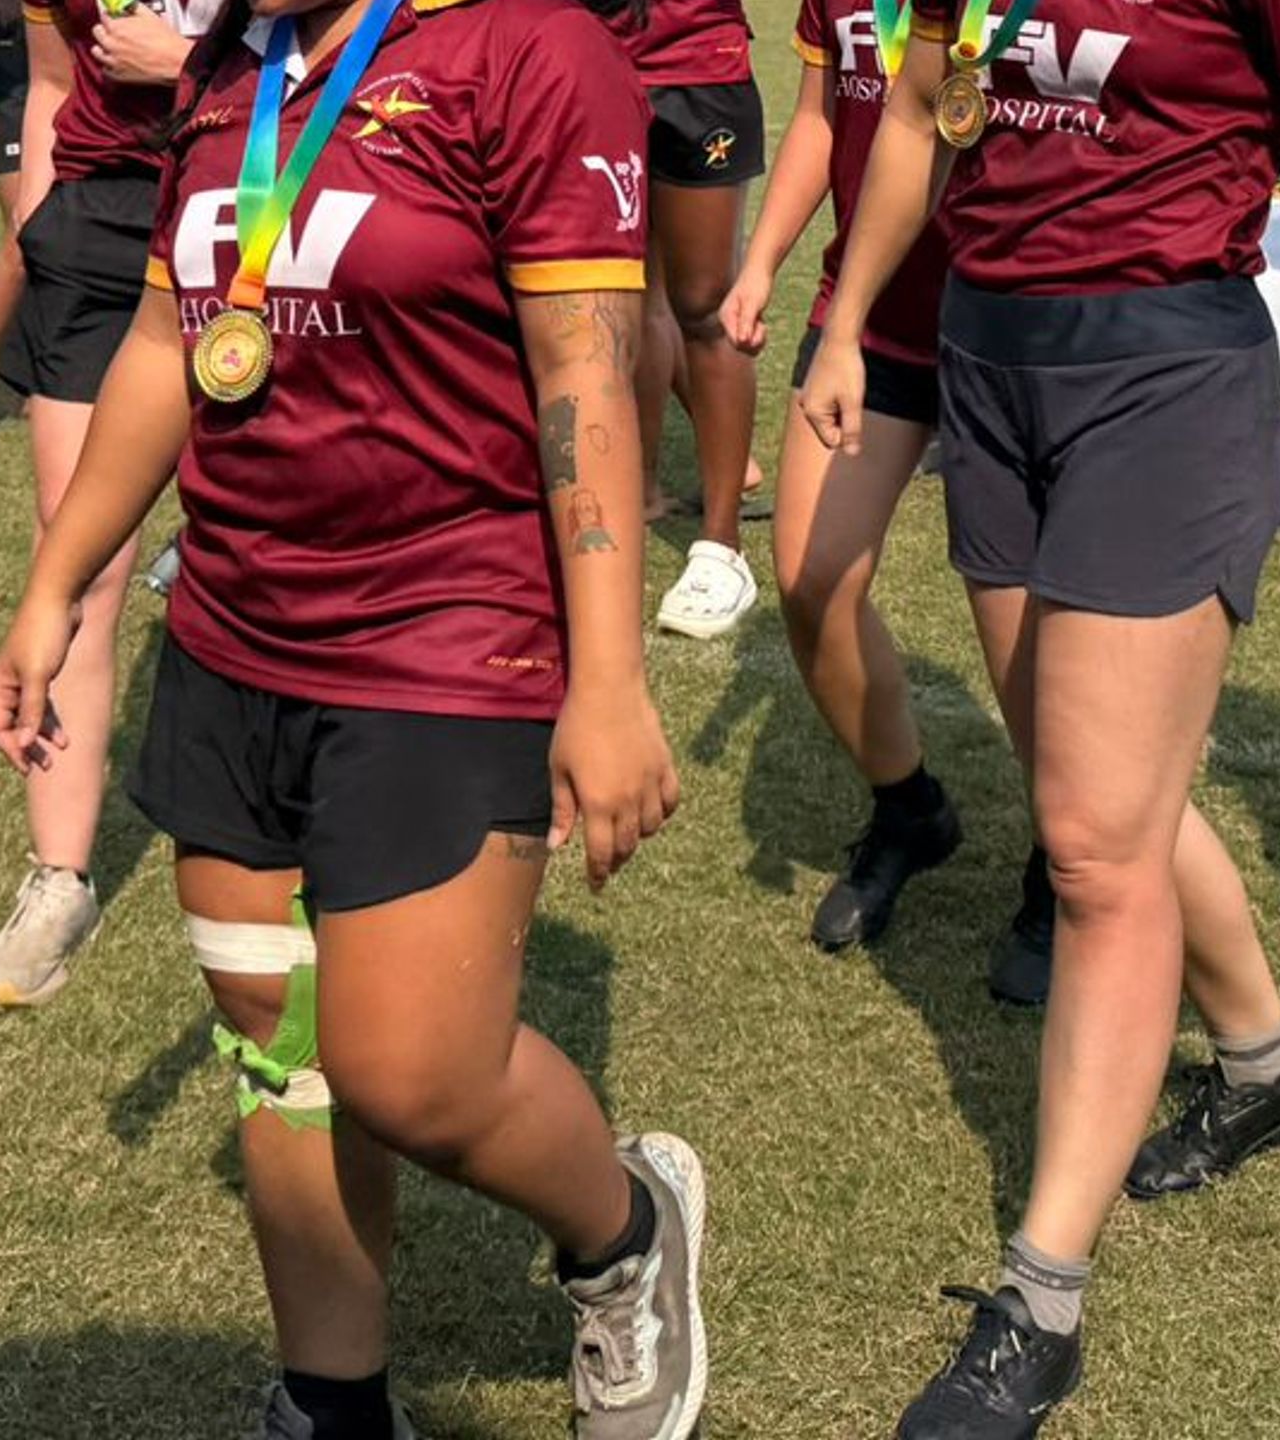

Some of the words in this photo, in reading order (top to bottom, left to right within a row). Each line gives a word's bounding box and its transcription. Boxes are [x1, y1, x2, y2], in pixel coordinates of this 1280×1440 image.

[984, 95, 1117, 143] OSPITAL
[173, 187, 377, 290] FV
[180, 296, 363, 337] HOITAL
